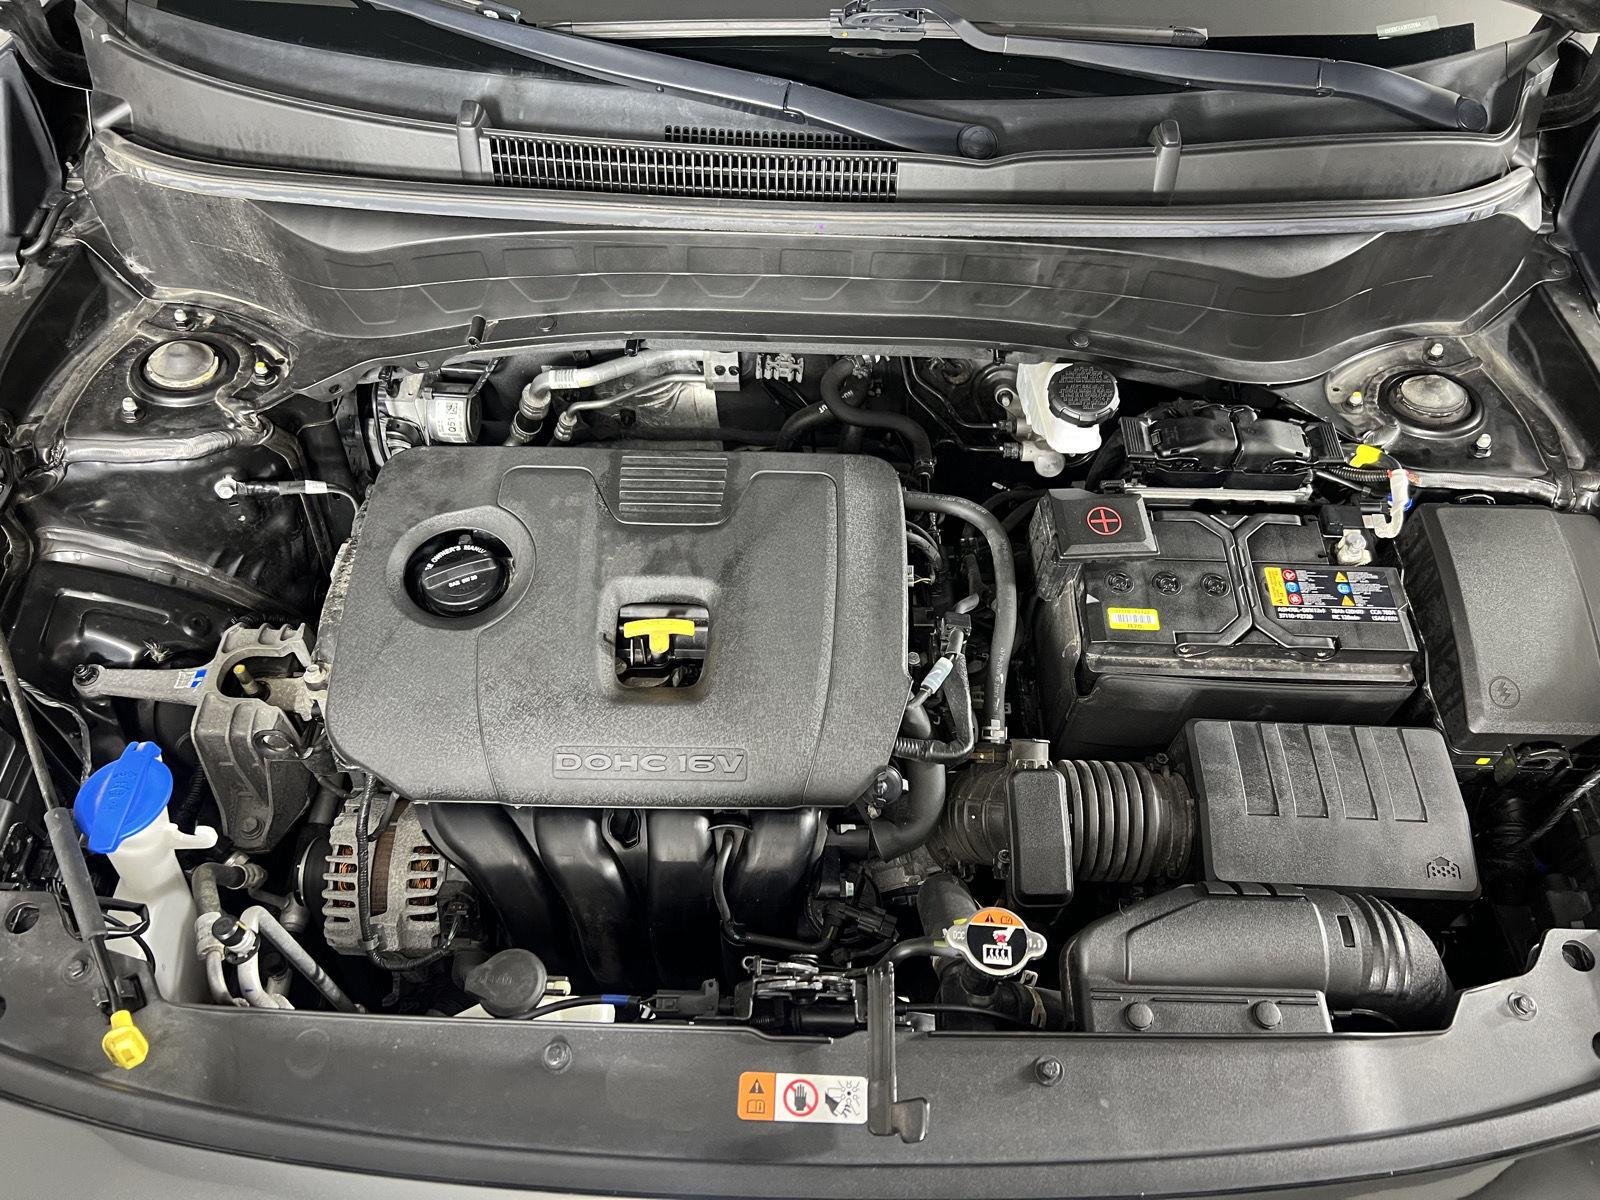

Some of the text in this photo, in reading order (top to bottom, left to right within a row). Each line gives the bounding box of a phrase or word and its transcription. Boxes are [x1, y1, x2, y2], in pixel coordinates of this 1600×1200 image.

[432, 545, 461, 562] OWNER'S
[555, 752, 744, 774] DOHC 16V
